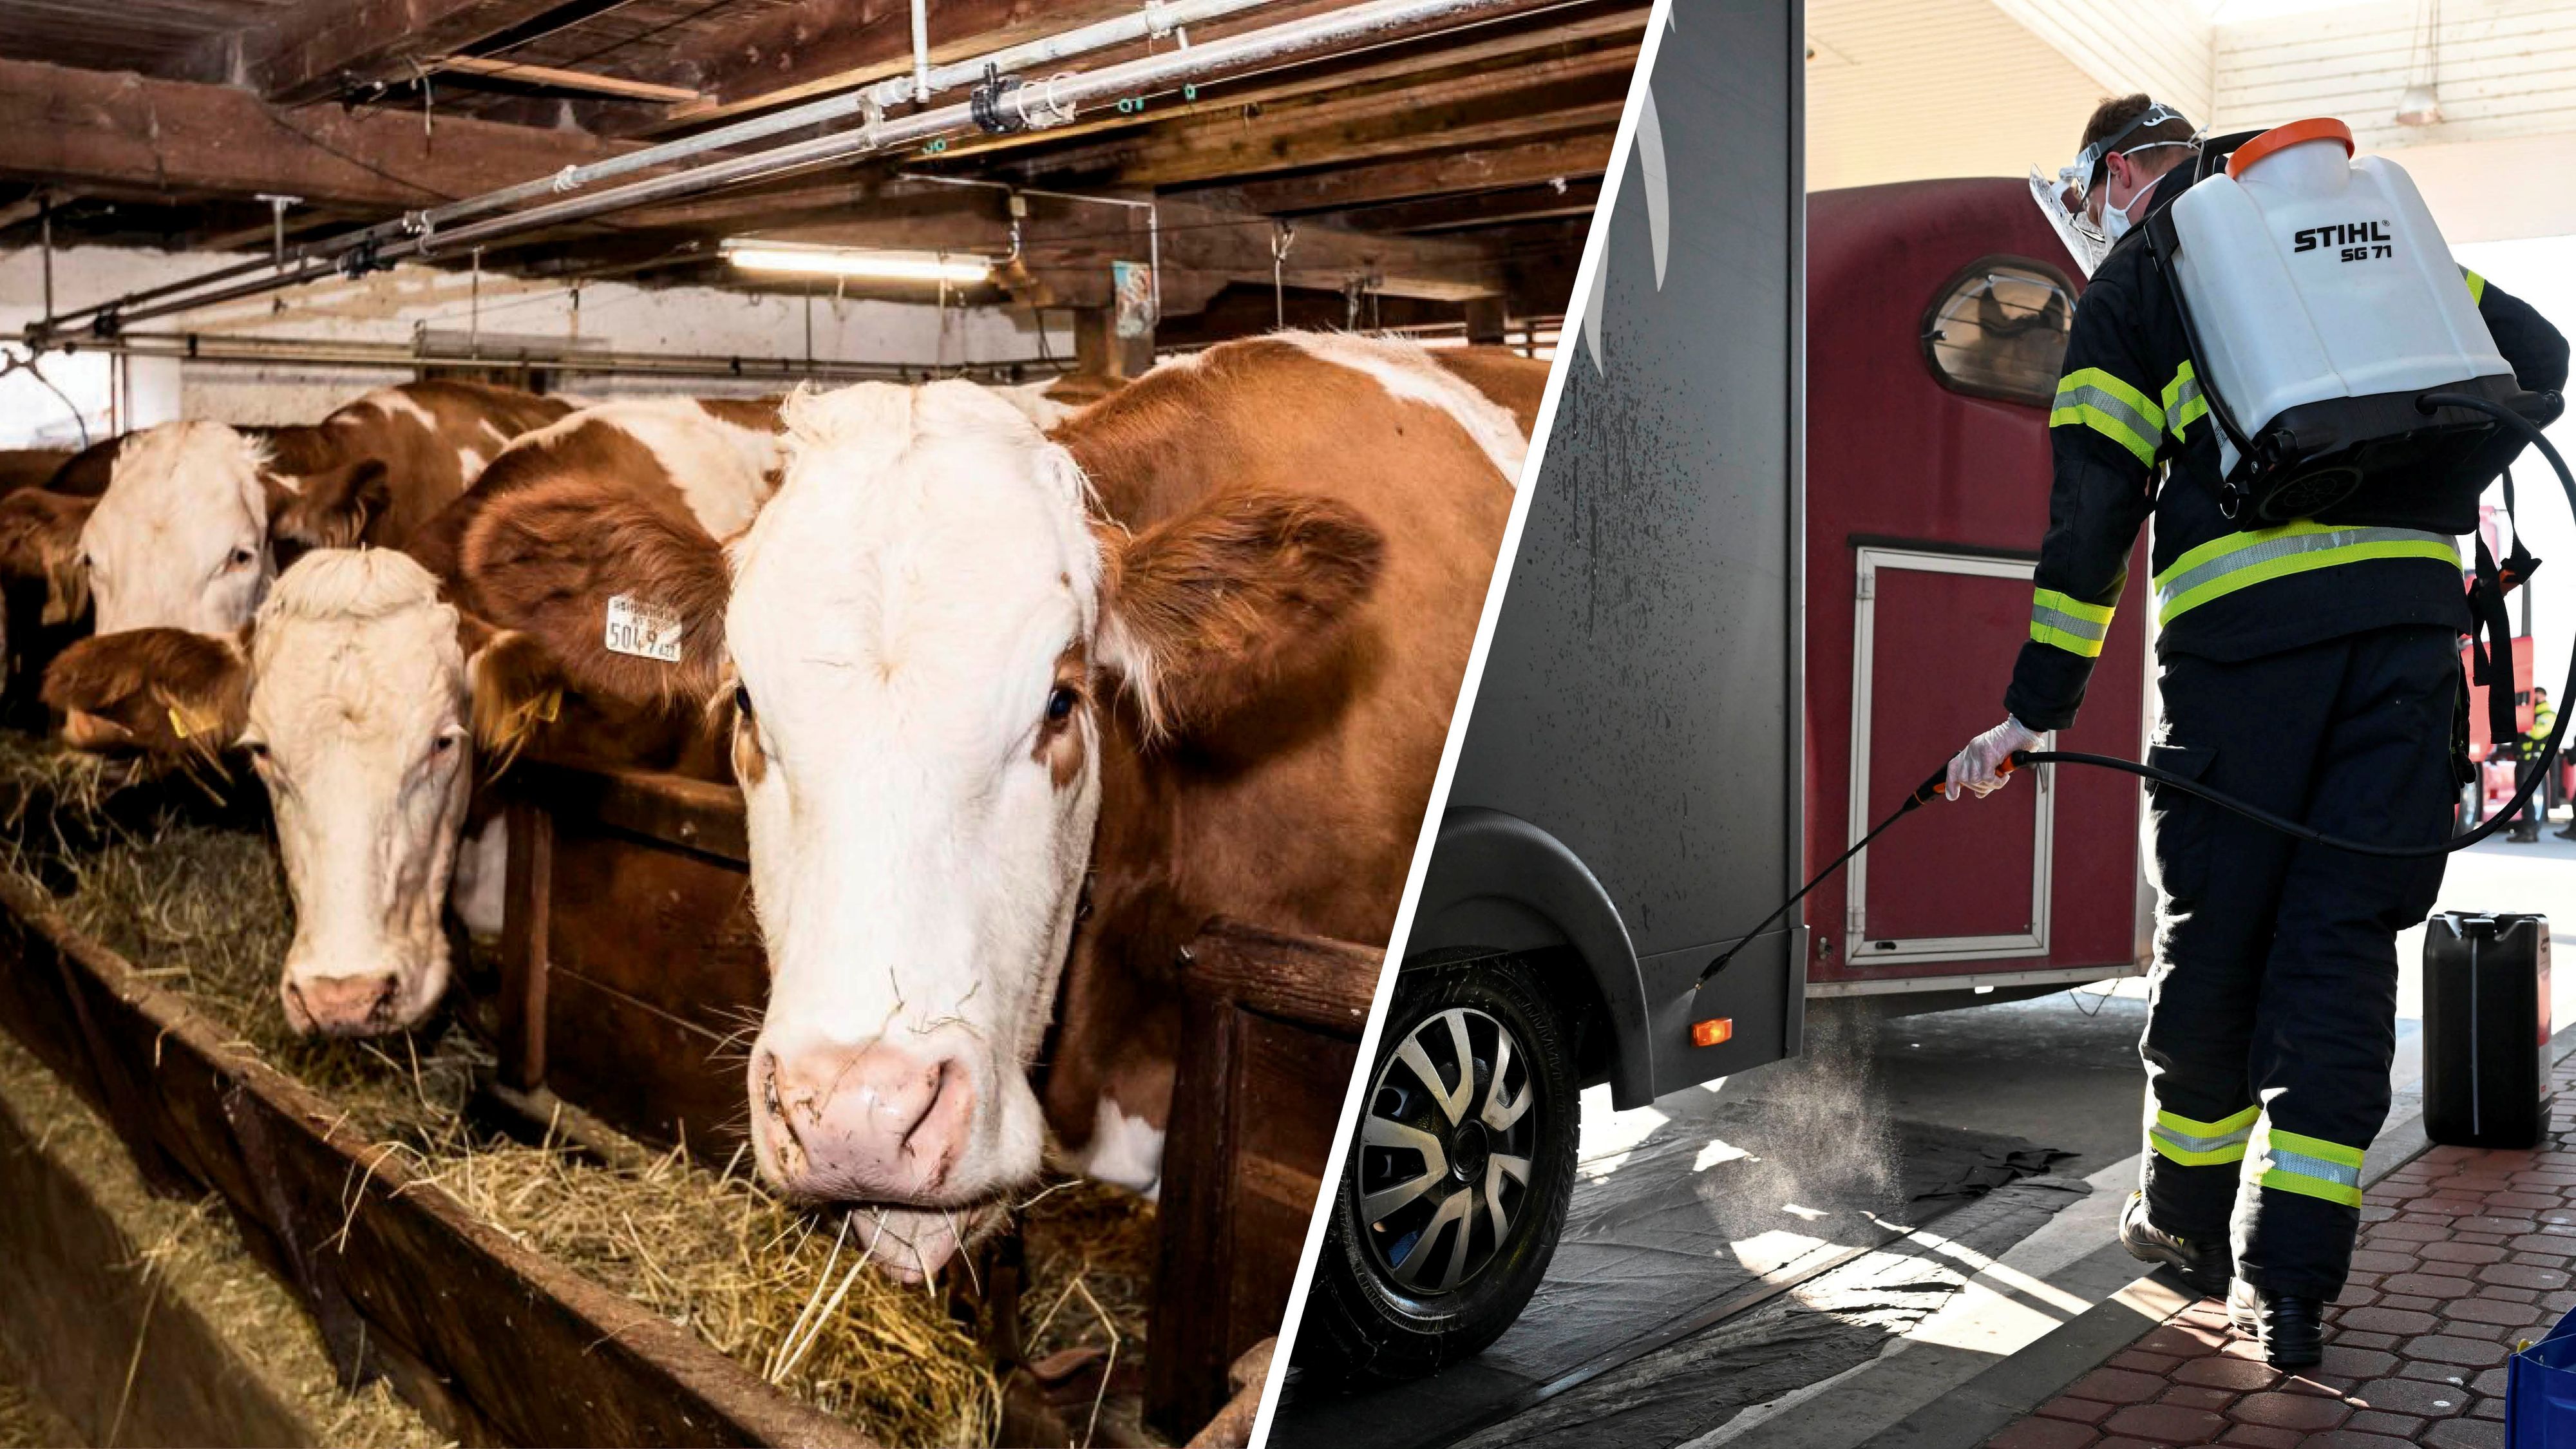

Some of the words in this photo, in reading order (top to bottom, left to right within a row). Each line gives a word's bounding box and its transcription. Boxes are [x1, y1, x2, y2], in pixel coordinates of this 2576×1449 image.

[2295, 222, 2391, 252] STIHL
[2341, 247, 2367, 262] SG
[2371, 245, 2392, 259] 71
